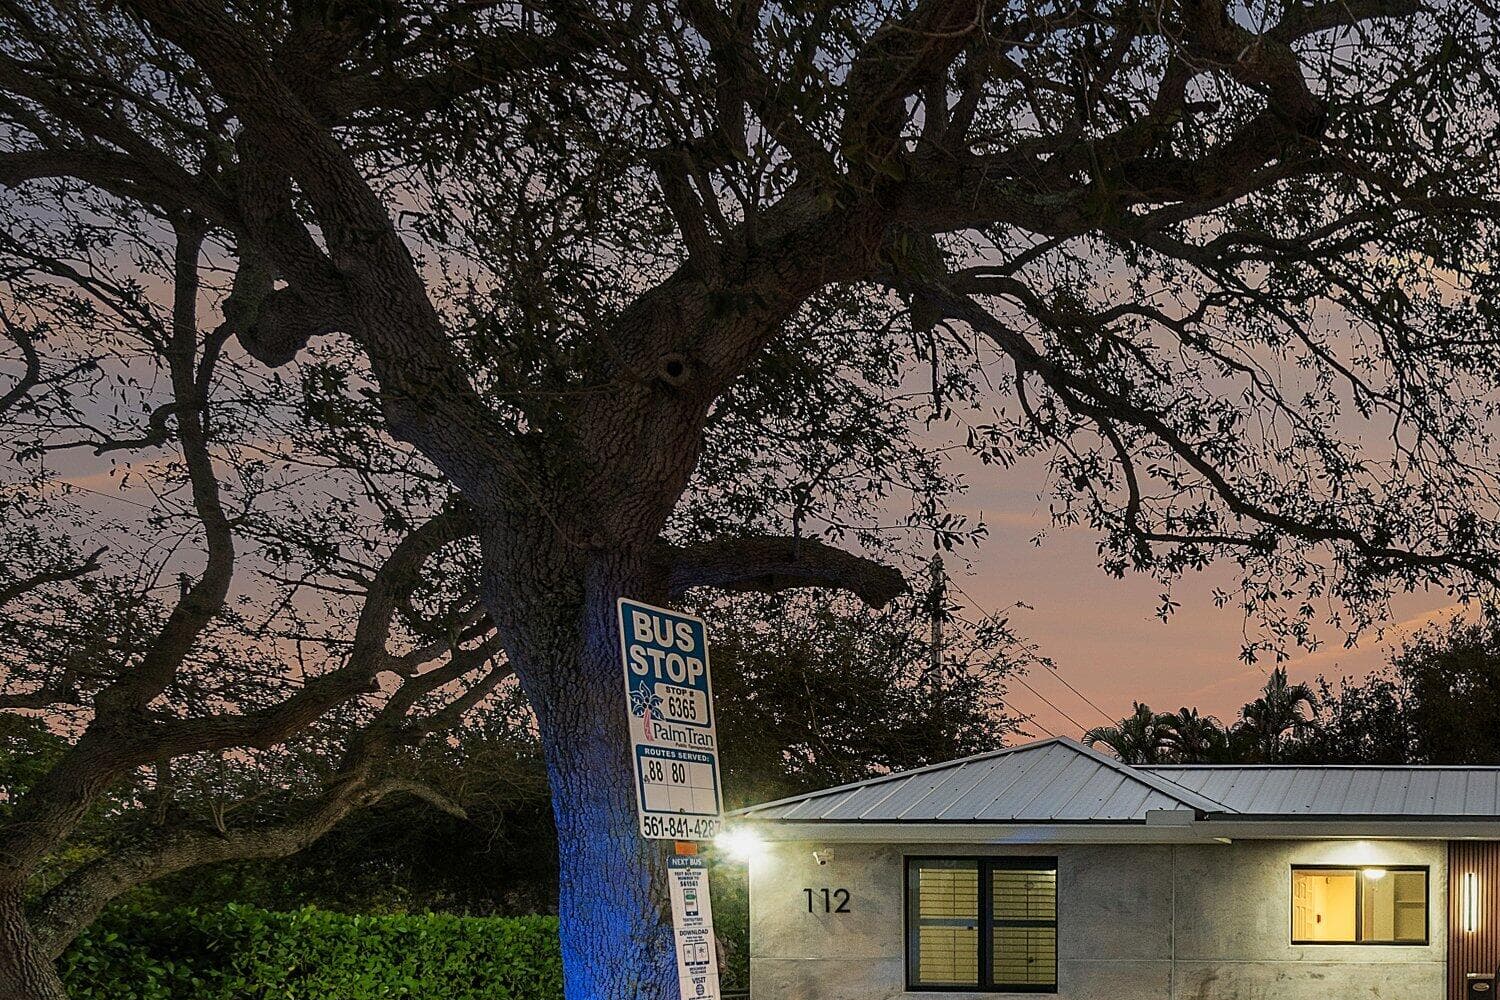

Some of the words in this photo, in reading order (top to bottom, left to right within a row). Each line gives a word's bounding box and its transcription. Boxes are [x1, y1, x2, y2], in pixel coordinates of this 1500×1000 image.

[632, 610, 695, 652] BUS
[629, 644, 704, 686] STOP
[665, 686, 687, 697] STOP
[669, 696, 697, 720] 6365
[653, 722, 714, 747] PalmTran
[645, 748, 676, 757] ROUTES
[678, 753, 709, 762] SERVED:
[648, 760, 663, 782] 88
[671, 762, 686, 784] 80
[643, 815, 721, 838] 561-841-4287
[803, 888, 851, 913] 112
